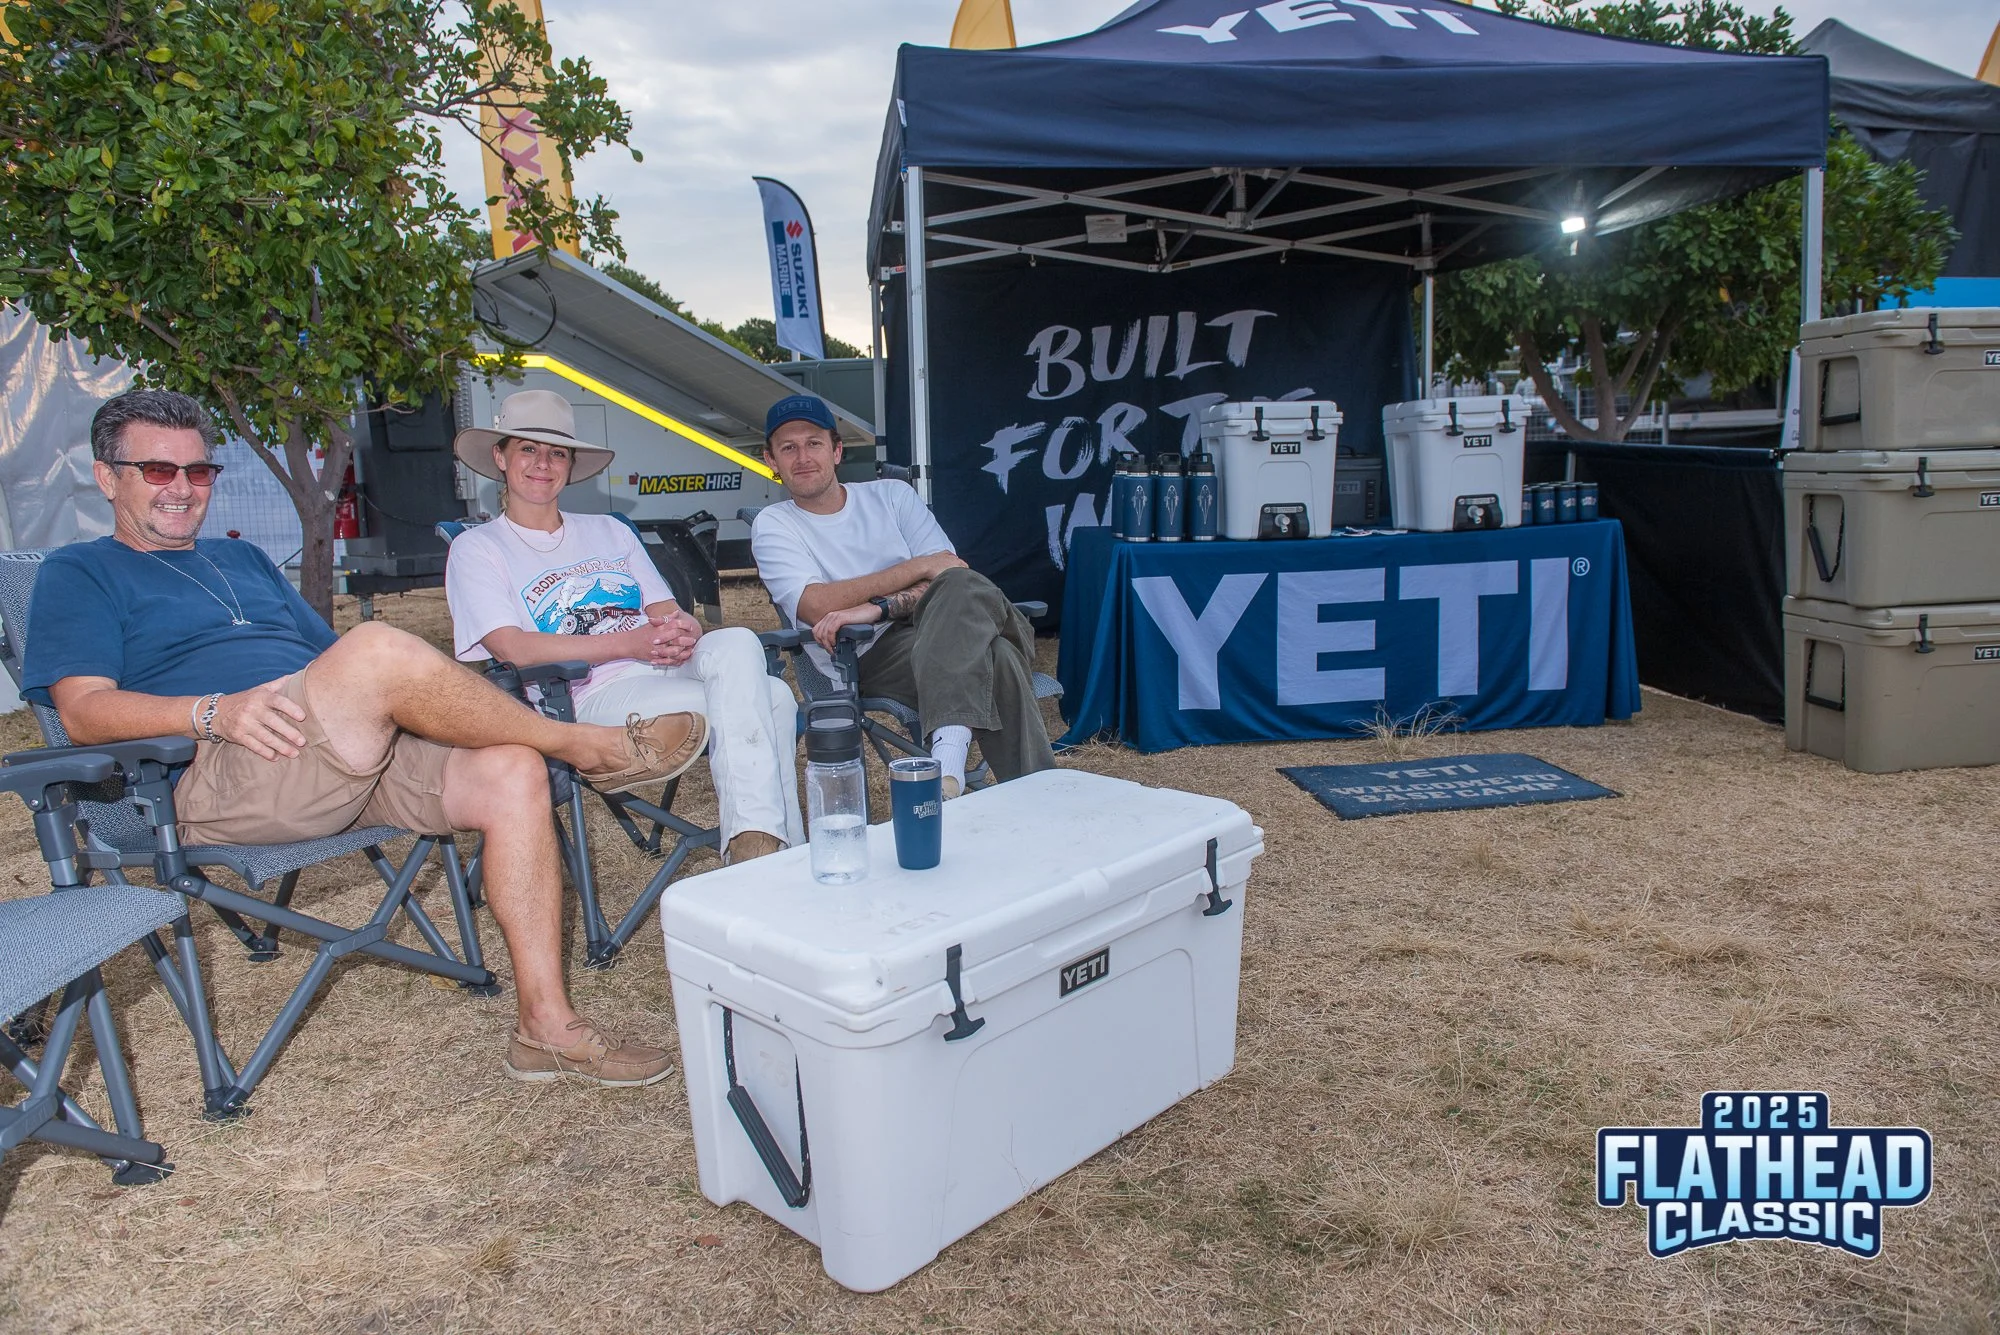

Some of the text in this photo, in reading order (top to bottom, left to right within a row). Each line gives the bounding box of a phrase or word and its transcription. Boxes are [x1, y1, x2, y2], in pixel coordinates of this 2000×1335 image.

[1155, 0, 1480, 43] YETI
[776, 244, 792, 296] MARINE
[791, 243, 809, 318] SUZUKI
[1024, 309, 1279, 400] BUILT
[980, 402, 1148, 495] FOR
[1272, 443, 1299, 453] YETI
[1464, 436, 1491, 447] YETI
[640, 473, 741, 494] MASTERHIRE
[1335, 482, 1359, 492] YETI
[1982, 494, 2000, 504] YE
[532, 572, 562, 596] RODE
[1976, 648, 2000, 658] YET
[1369, 764, 1479, 779] YETI
[1329, 774, 1563, 795] WELCOME TO
[1354, 790, 1452, 803] BASE
[1063, 954, 1106, 989] YETI
